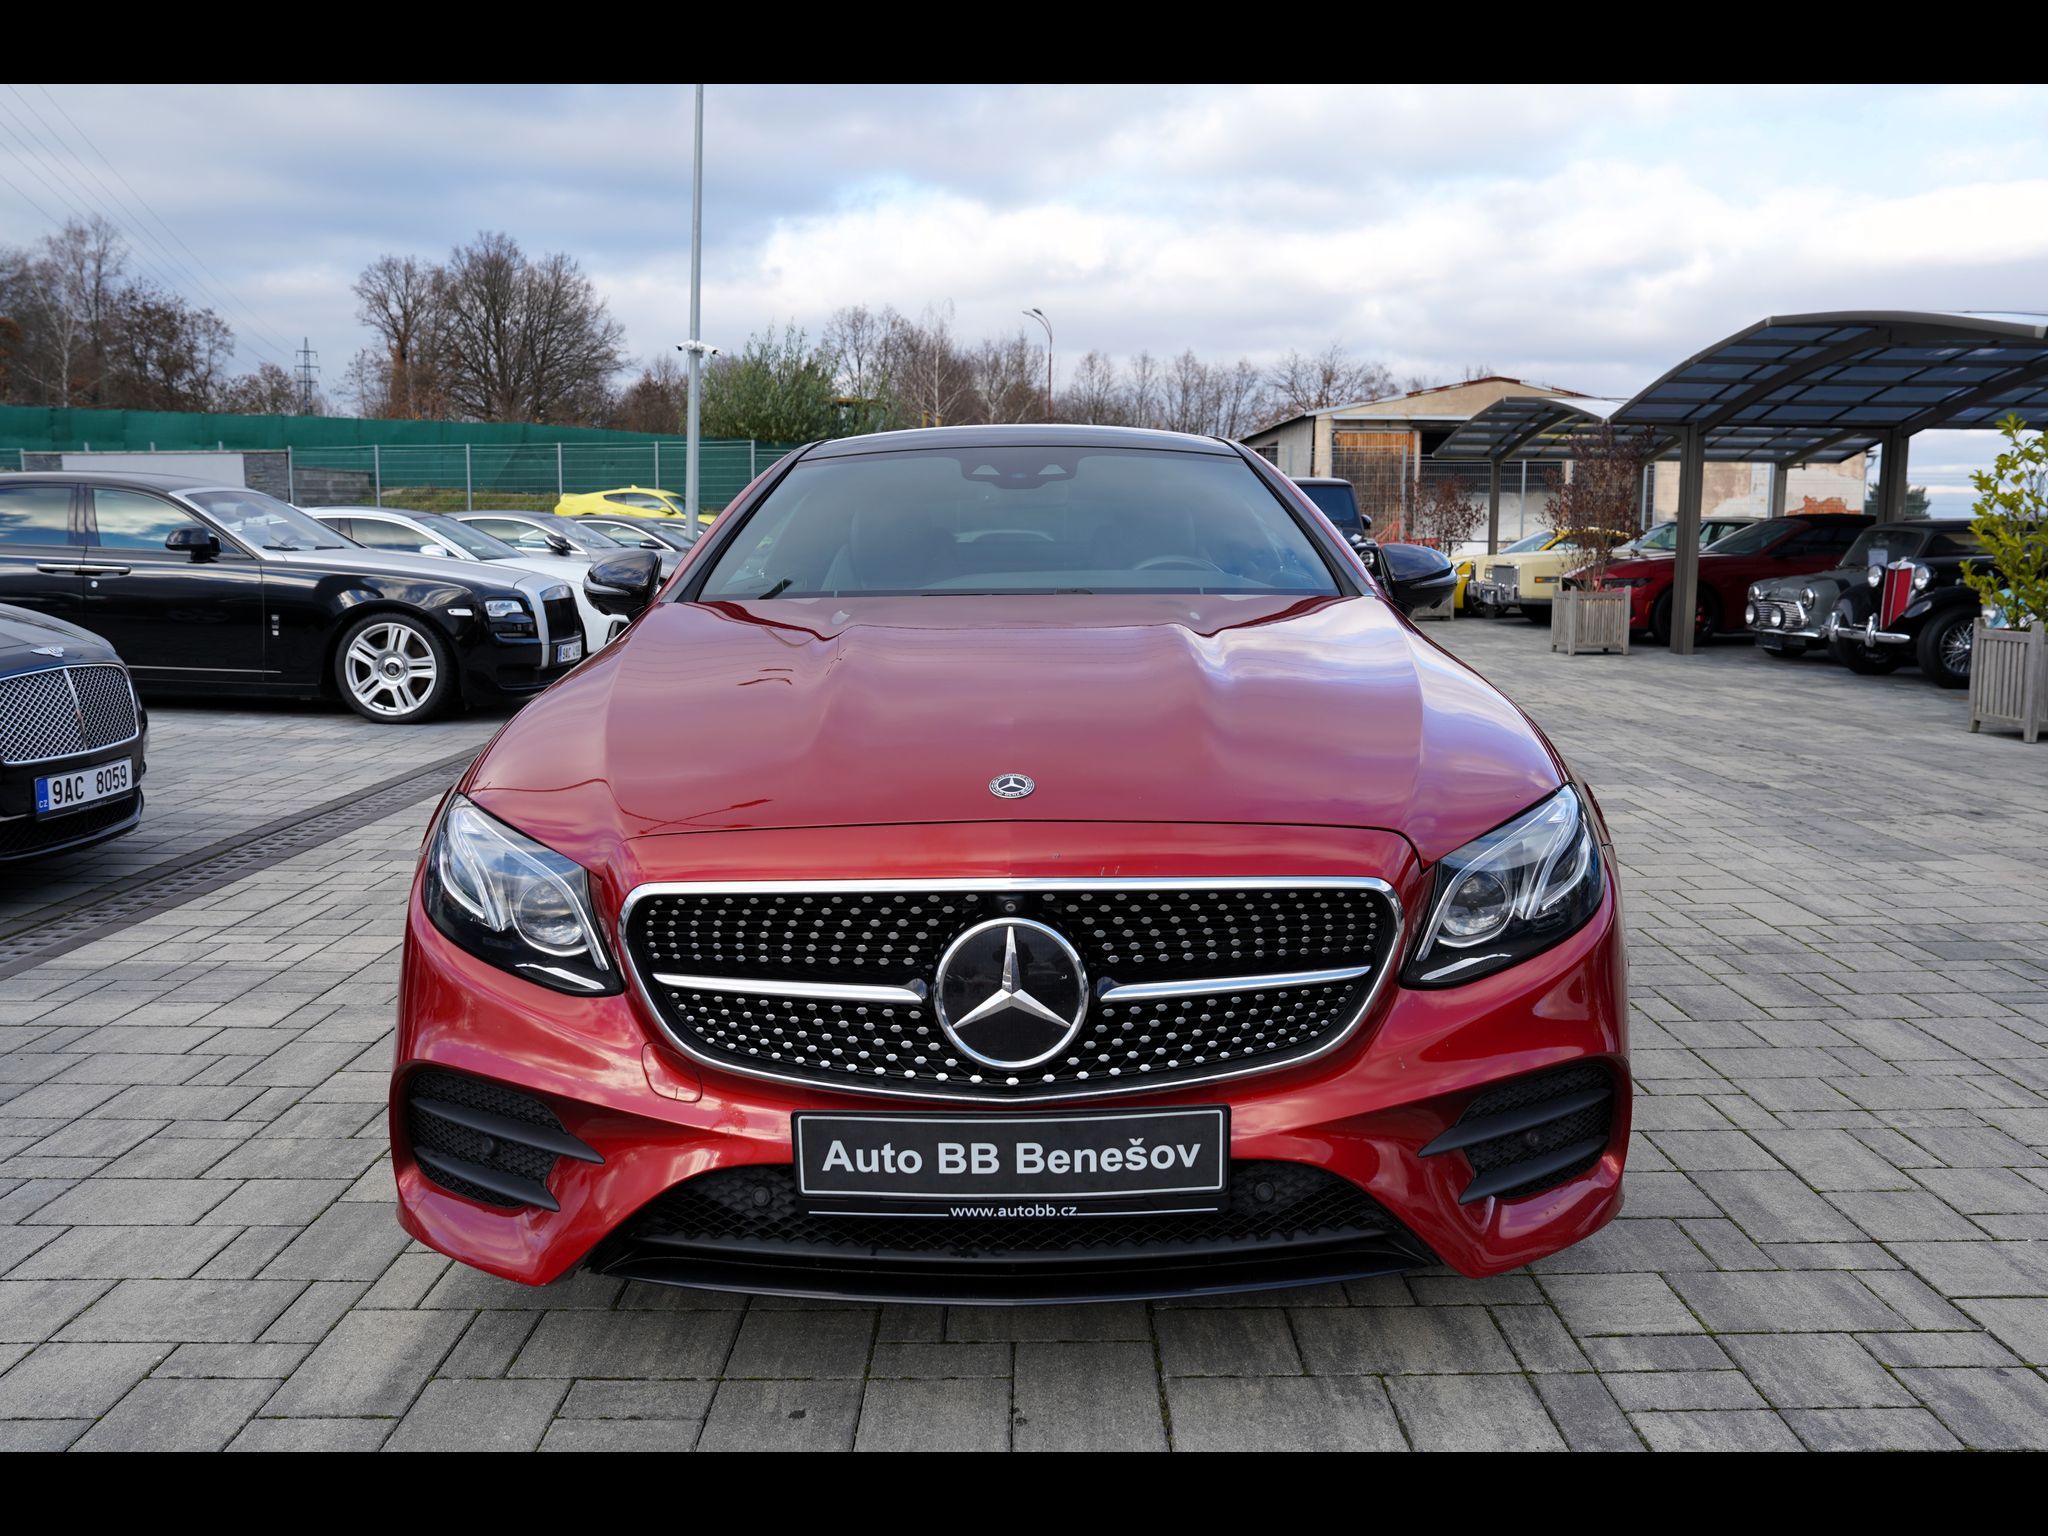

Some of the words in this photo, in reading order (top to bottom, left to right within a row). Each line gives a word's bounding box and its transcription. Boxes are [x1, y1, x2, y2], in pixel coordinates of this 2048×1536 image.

[52, 776, 84, 804] 9AC
[96, 764, 127, 794] 8059
[39, 799, 48, 808] CZ
[822, 1140, 923, 1174] Auto
[937, 1142, 1000, 1175] BB
[1016, 1137, 1201, 1175] Benešov
[950, 1204, 1077, 1218] www.autobb.cz
